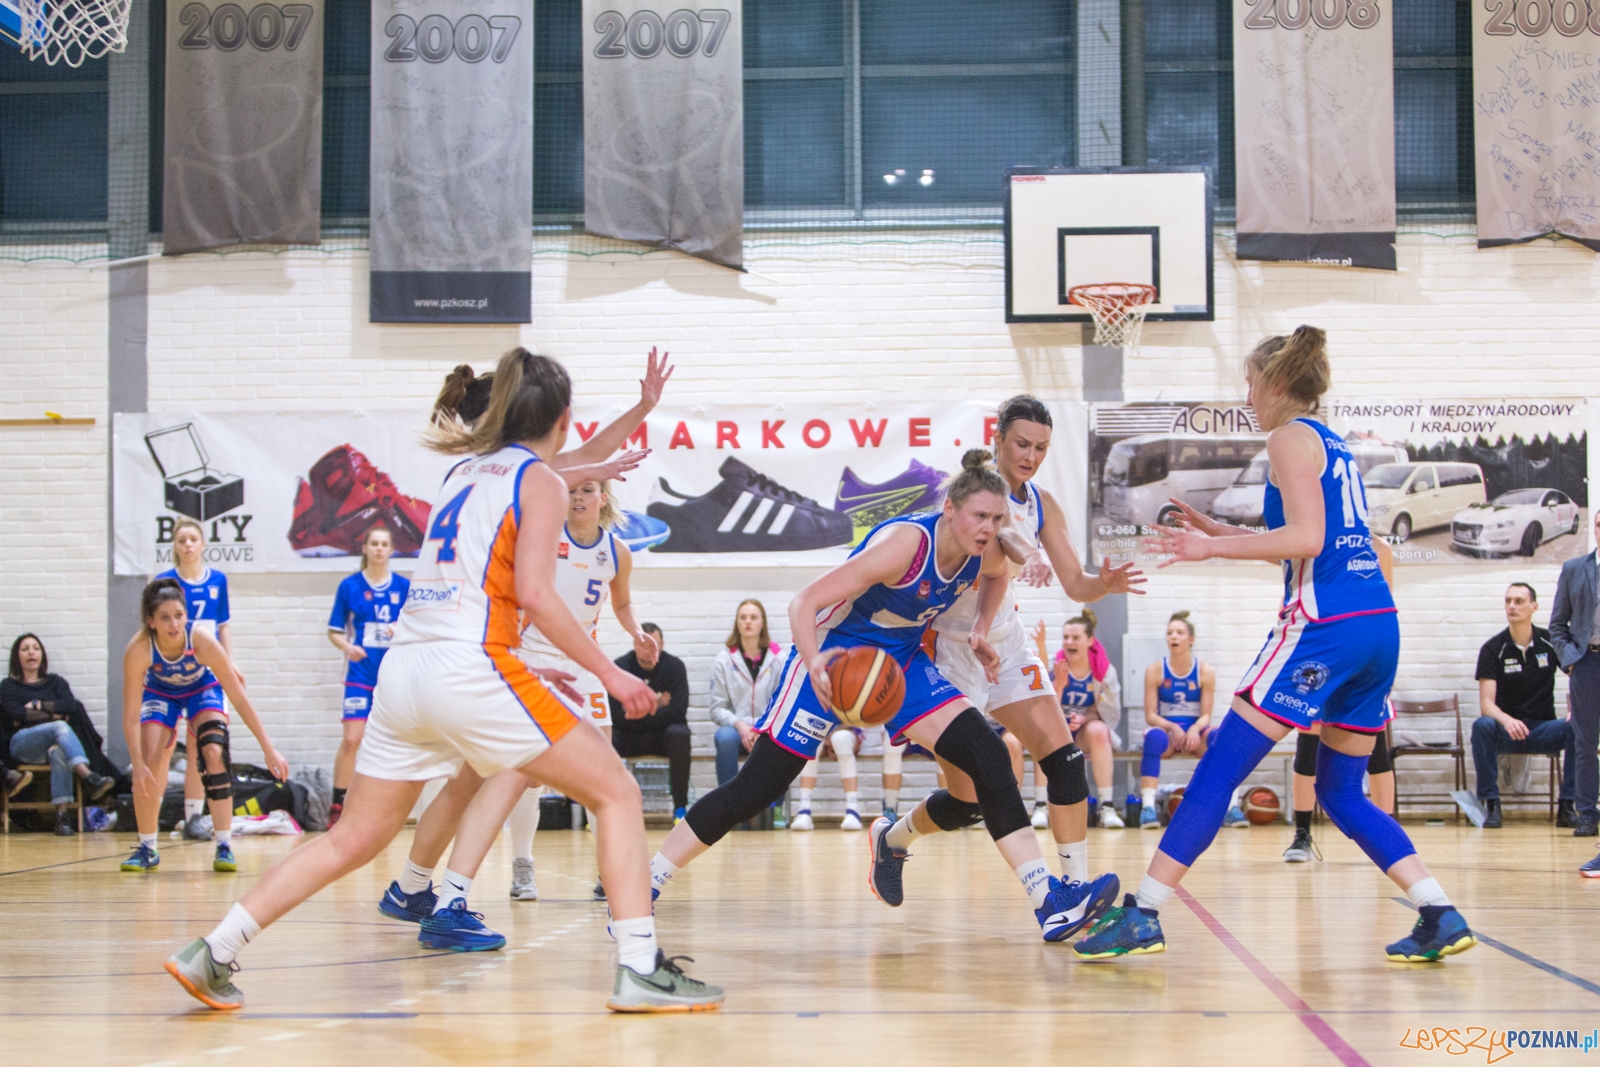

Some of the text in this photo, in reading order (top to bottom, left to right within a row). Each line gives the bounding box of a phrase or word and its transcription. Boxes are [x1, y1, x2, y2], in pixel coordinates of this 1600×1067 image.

[179, 3, 313, 51] 2007
[1244, 0, 1381, 30] 2008
[1484, 0, 1600, 37] 200
[384, 14, 522, 63] 2007
[592, 9, 731, 59] 2007
[414, 298, 488, 309] www.pzkosz.pl
[1172, 407, 1253, 433] AGMA
[1333, 404, 1574, 419] TRANSPORT MIĘDZYNARODOWY
[1410, 421, 1496, 433] I KRAJOWY
[156, 515, 252, 543] BTY
[428, 484, 475, 564] 4
[1099, 525, 1136, 535] 62-060
[156, 547, 253, 563] MKOWE
[584, 578, 602, 606] 5
[192, 600, 207, 620] 7
[374, 604, 391, 622] 14
[1021, 664, 1044, 691] 7
[590, 692, 607, 719] 5
[1067, 691, 1088, 706] 17
[1273, 691, 1309, 711] green
